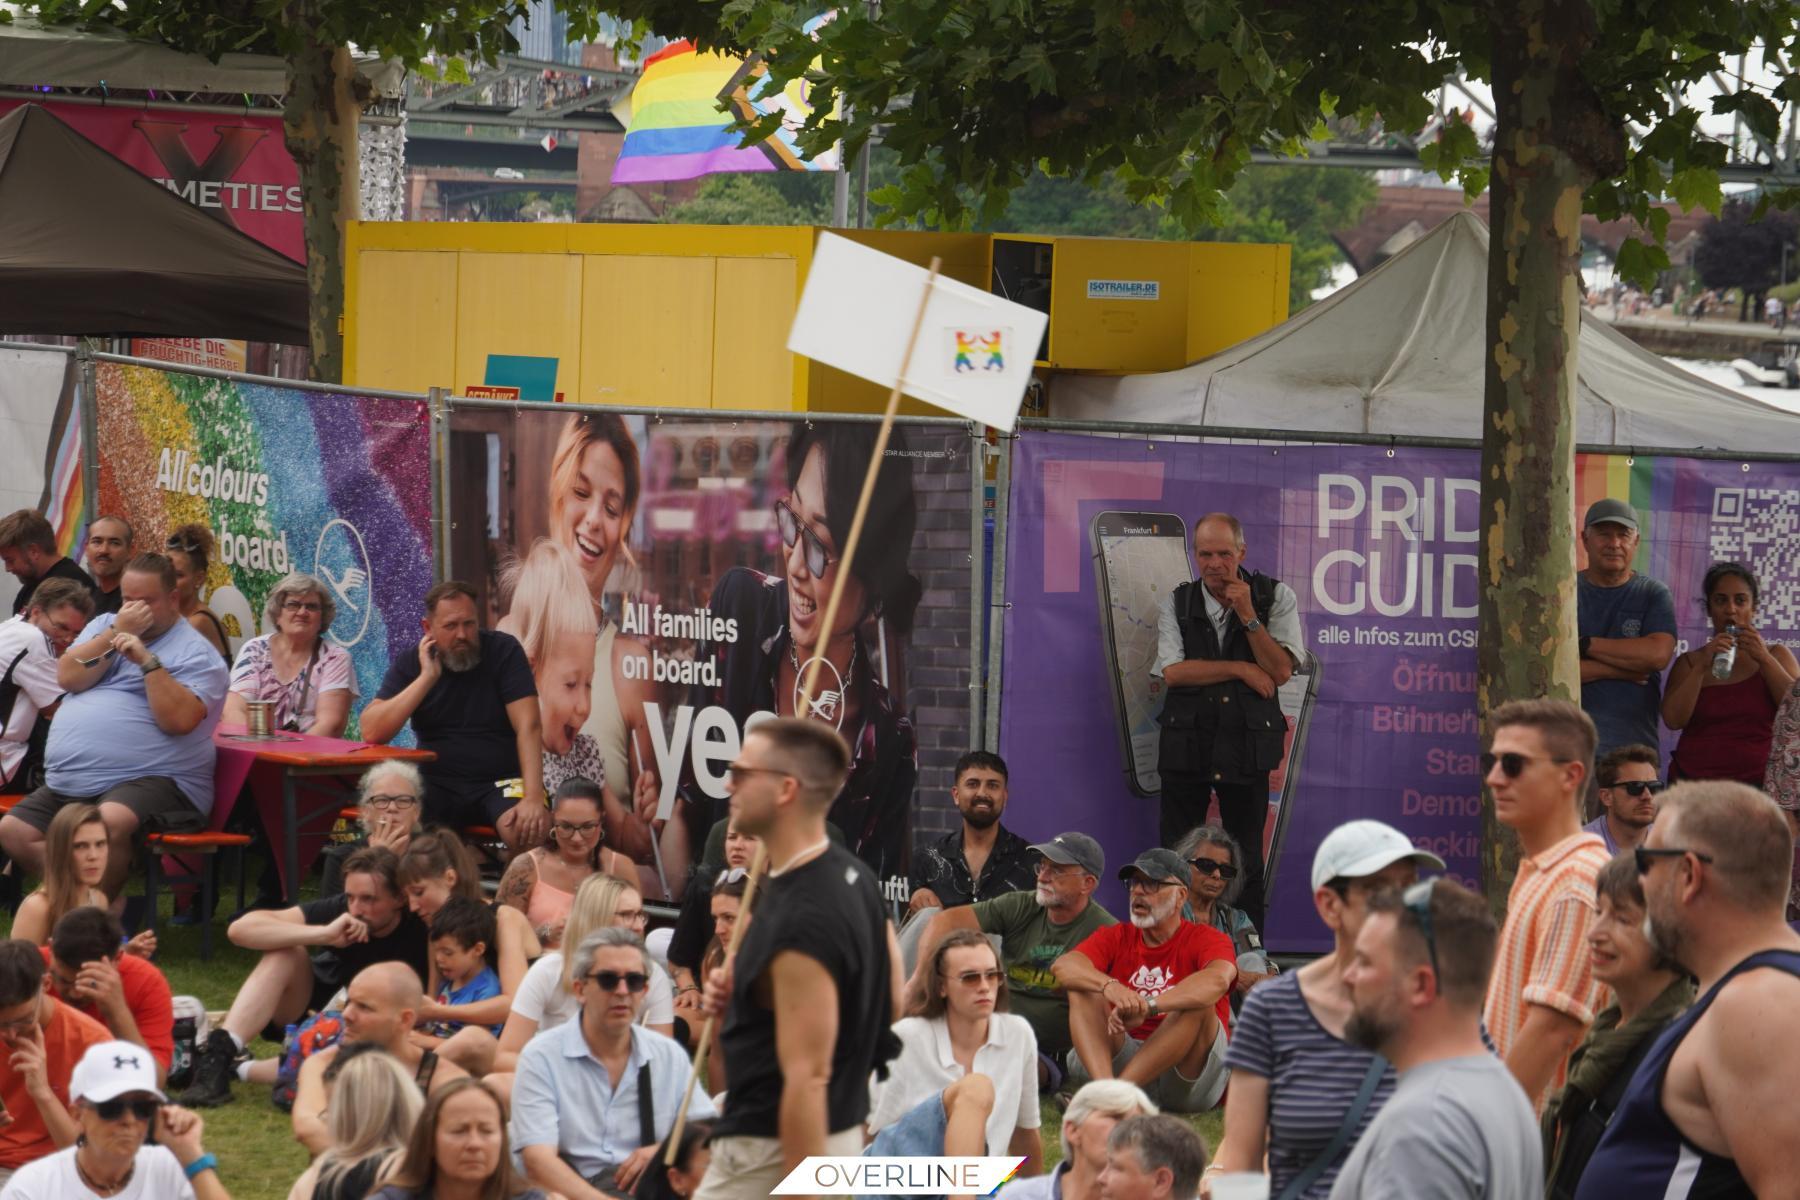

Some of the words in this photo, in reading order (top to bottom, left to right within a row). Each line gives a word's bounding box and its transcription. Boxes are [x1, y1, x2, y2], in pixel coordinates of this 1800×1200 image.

[1089, 282, 1157, 293] ISOTRAILER.DE
[206, 340, 225, 356] DIE
[155, 448, 187, 493] All
[186, 455, 269, 507] colours
[1123, 527, 1153, 535] Frankfurt
[621, 602, 649, 636] All
[653, 604, 739, 643] families
[1318, 625, 1351, 645] alle
[1354, 626, 1400, 646] Infos
[1404, 631, 1444, 647] zum
[622, 654, 648, 680] on
[652, 649, 722, 687] board.
[642, 701, 780, 821] ye
